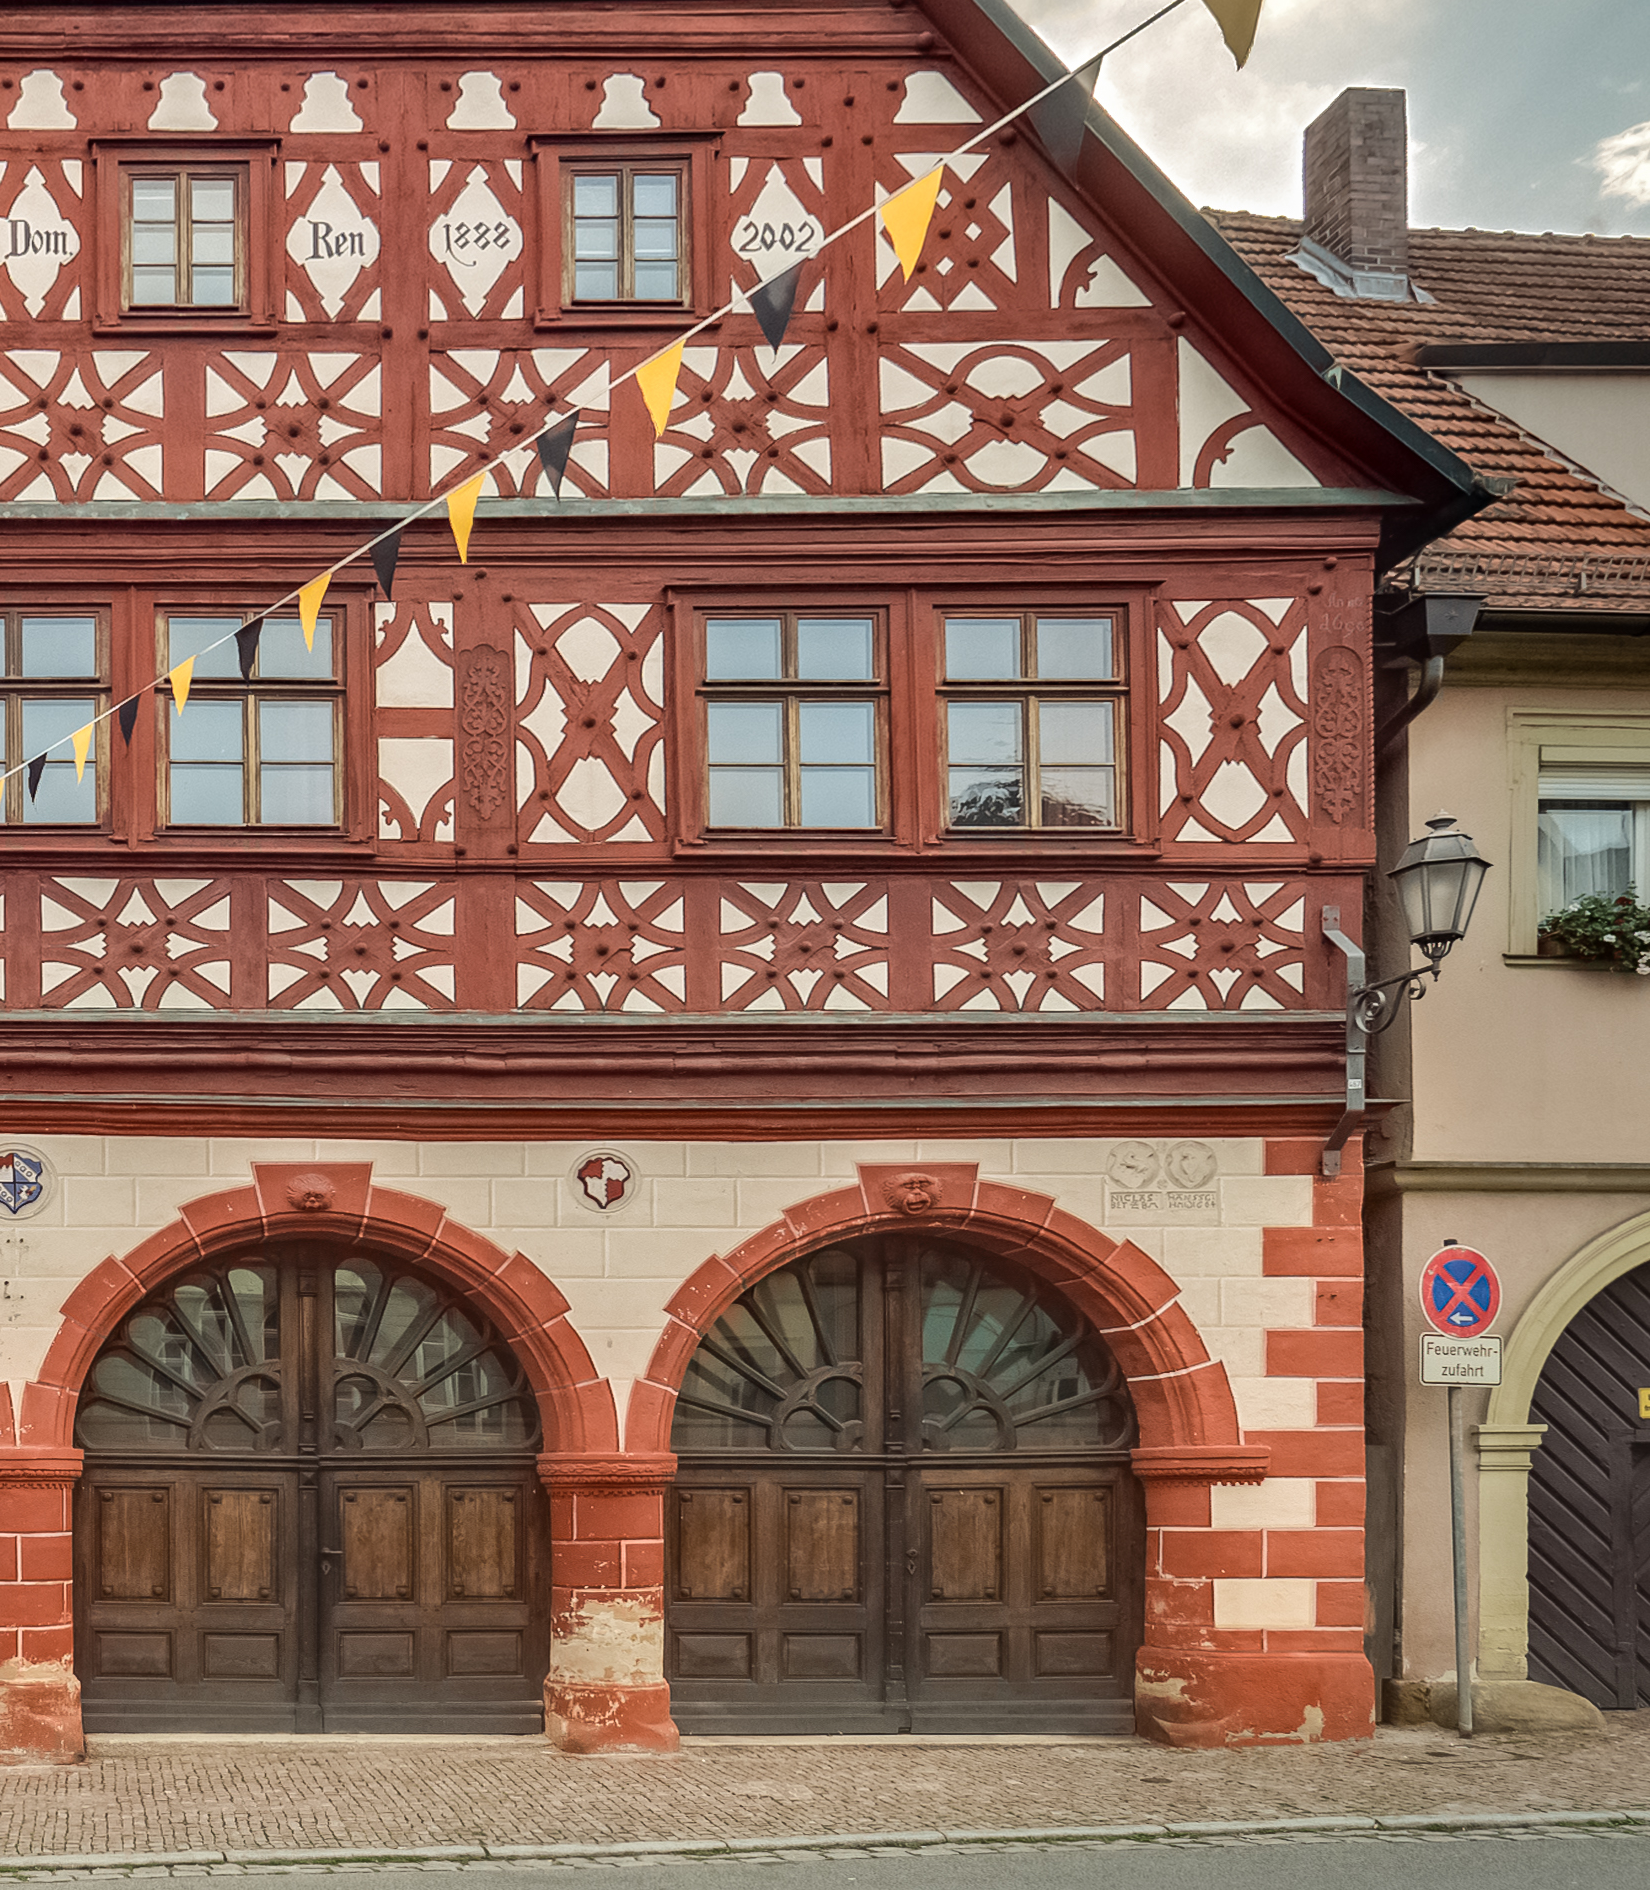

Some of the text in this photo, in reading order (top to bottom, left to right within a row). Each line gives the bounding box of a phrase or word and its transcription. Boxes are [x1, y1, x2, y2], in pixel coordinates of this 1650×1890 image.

[305, 219, 366, 261] Ren
[443, 221, 511, 267] 1888
[738, 220, 815, 252] 2002
[1426, 1341, 1498, 1357] Feuerwehr-
[1441, 1363, 1484, 1377] zufahrt
